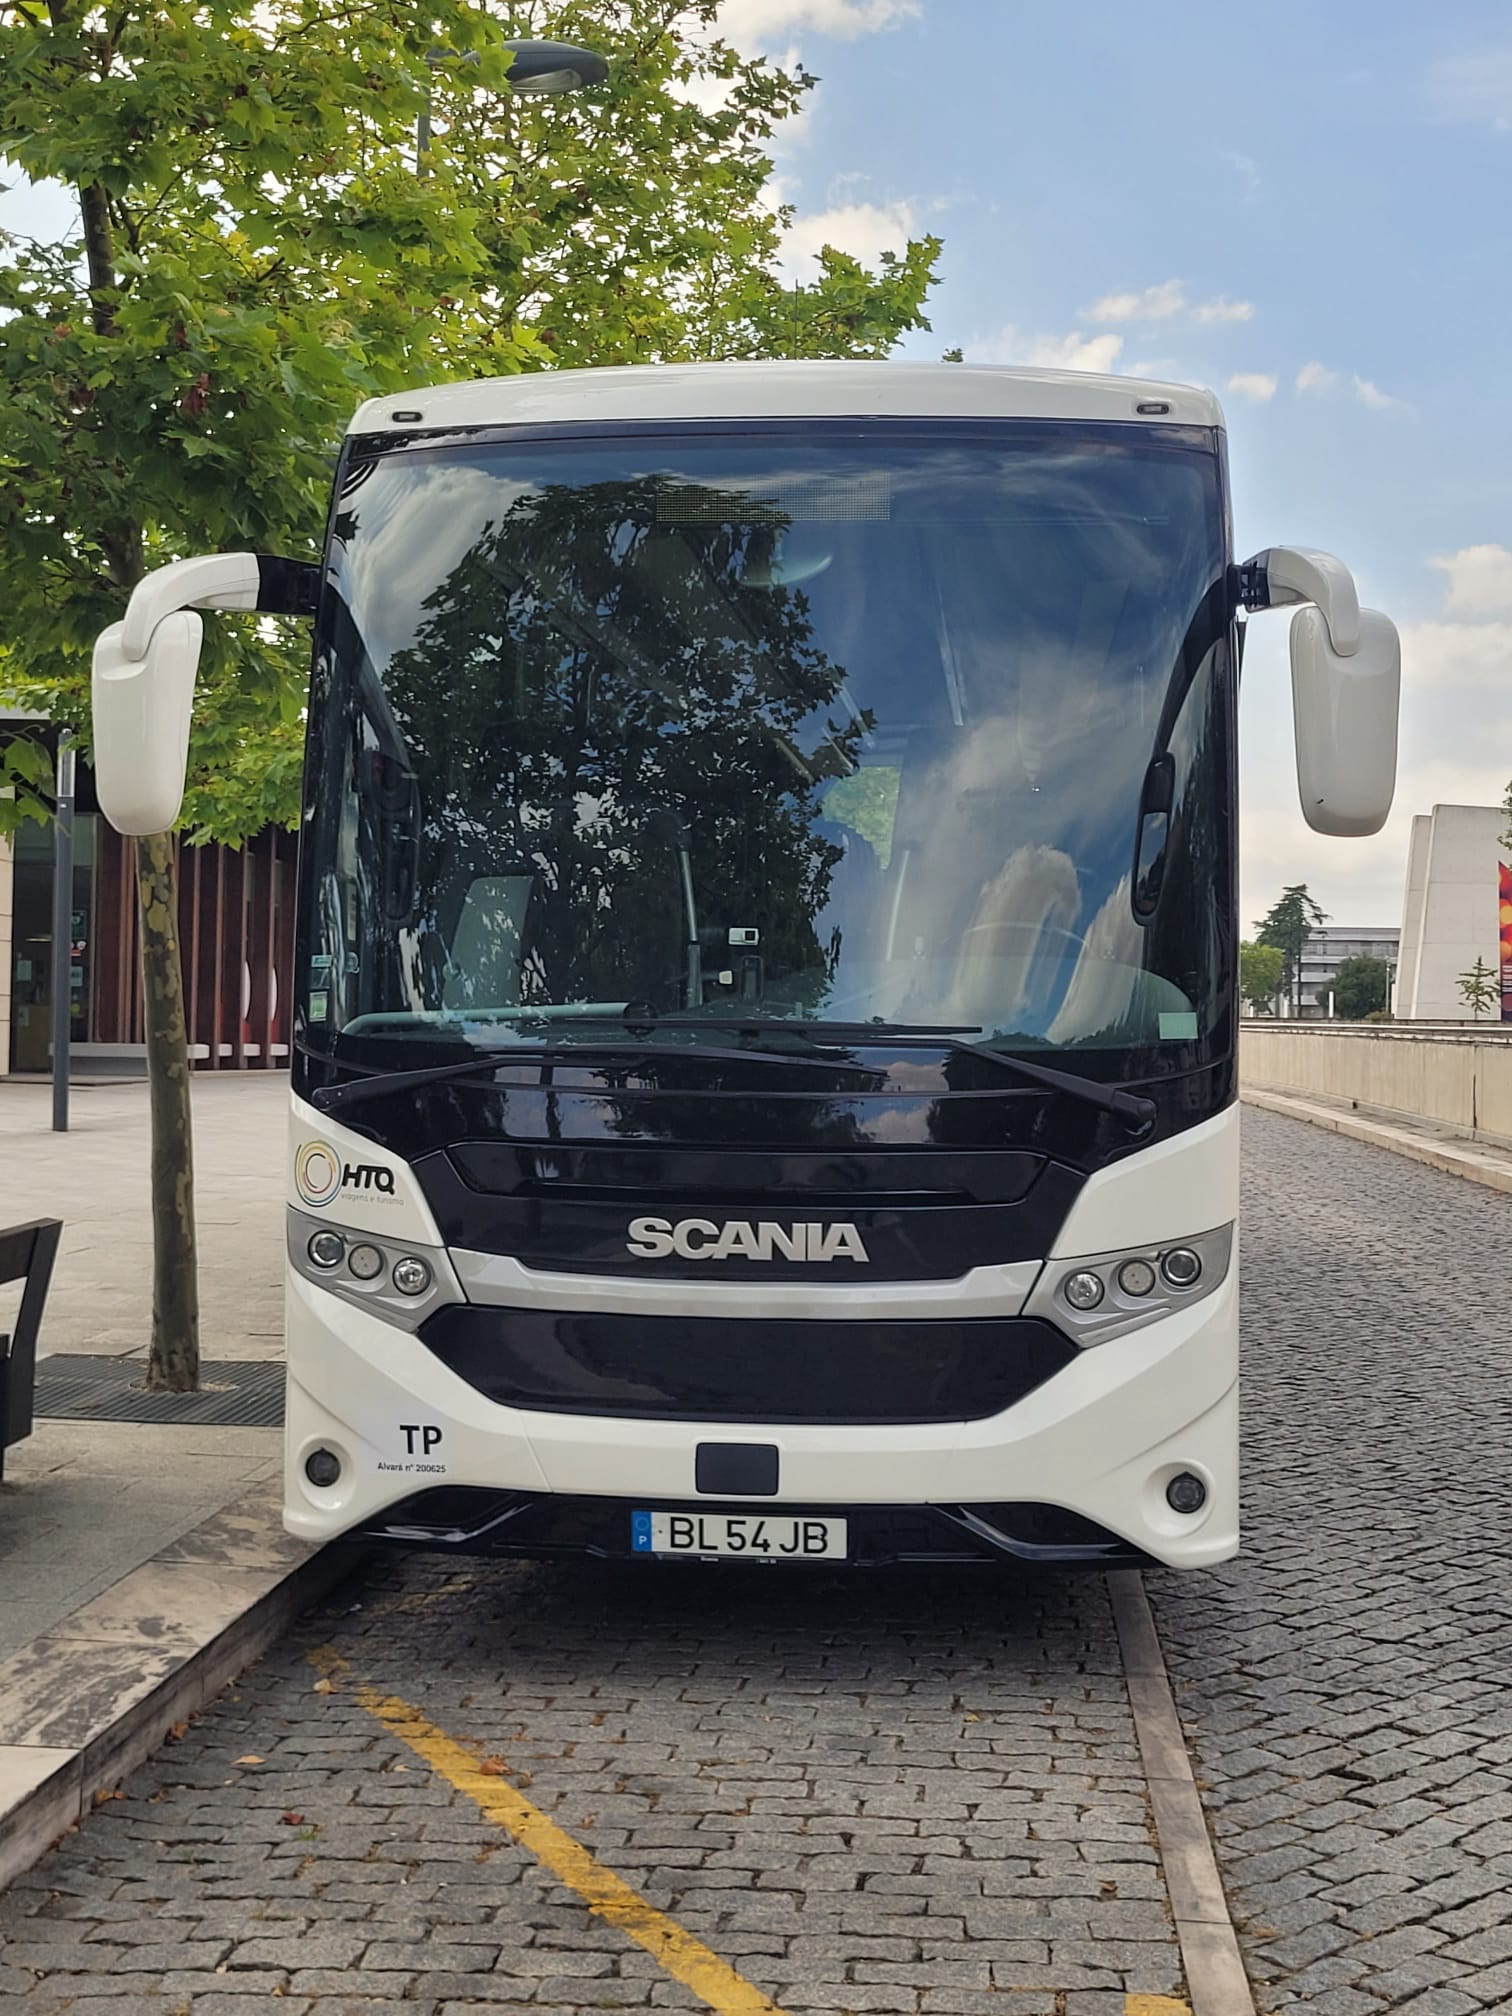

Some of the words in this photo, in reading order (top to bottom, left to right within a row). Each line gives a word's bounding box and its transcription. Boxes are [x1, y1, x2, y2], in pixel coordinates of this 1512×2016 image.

[341, 1163, 395, 1195] HTQ
[626, 1216, 870, 1262] SCANIA
[399, 1425, 443, 1455] TP
[638, 1535, 647, 1545] P
[670, 1516, 718, 1550] BL
[726, 1519, 771, 1552] 54
[779, 1521, 828, 1554] JB
